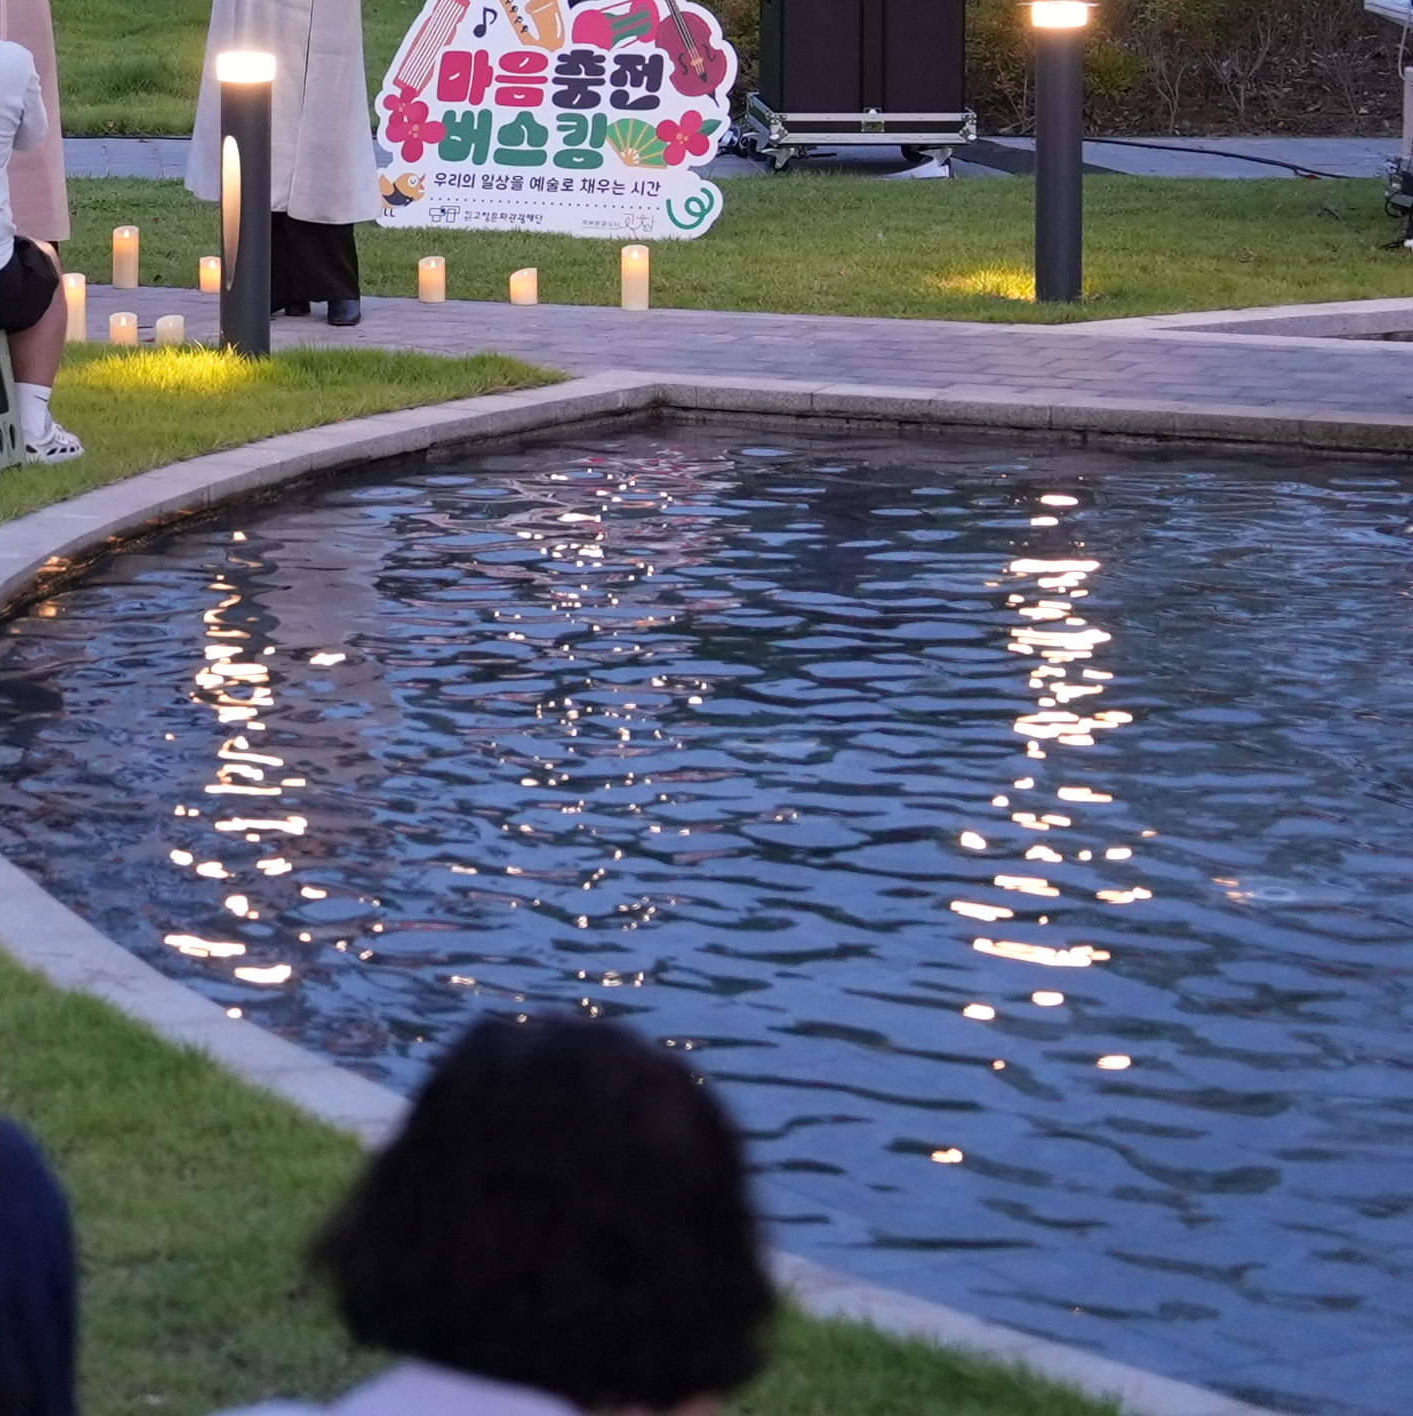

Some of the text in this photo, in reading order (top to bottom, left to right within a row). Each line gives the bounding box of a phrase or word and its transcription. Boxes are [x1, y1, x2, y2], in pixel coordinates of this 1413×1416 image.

[438, 108, 608, 170] 버스킹
[434, 172, 661, 197] 우리의 일상을 예술로 채우는 시간
[473, 211, 543, 225] 고창문화관광재단
